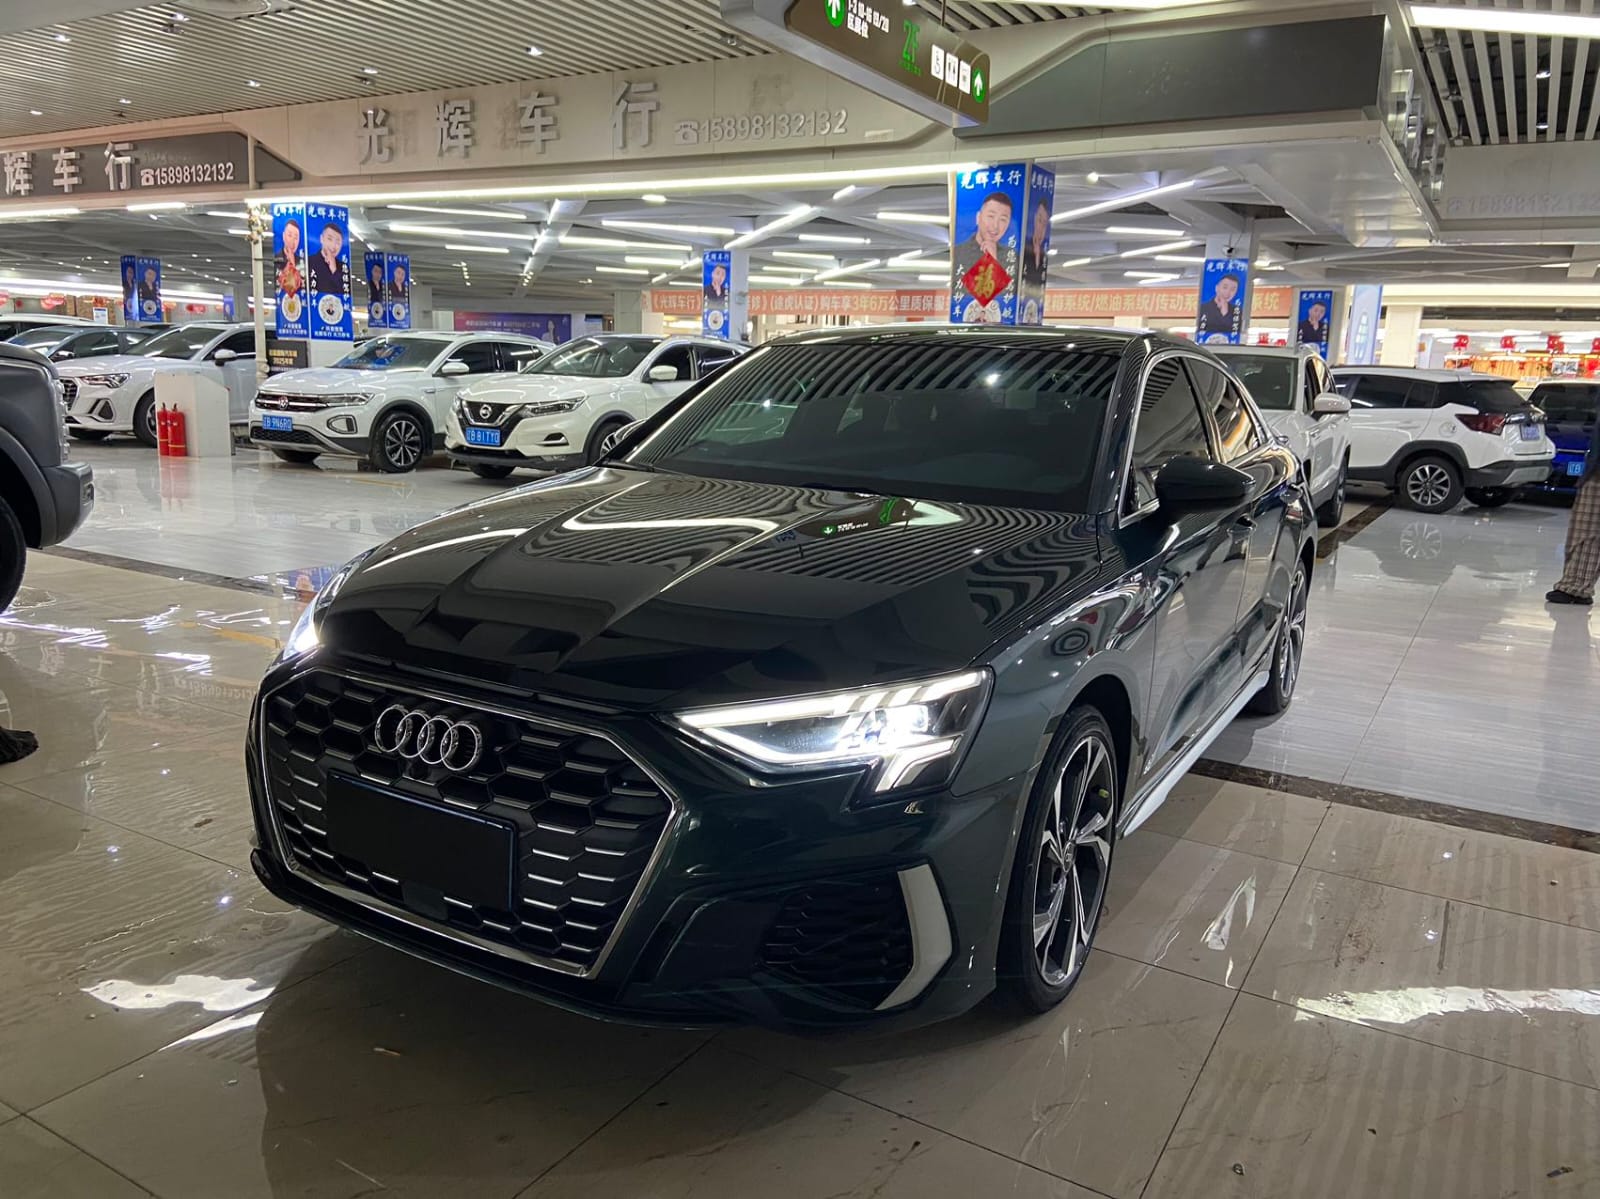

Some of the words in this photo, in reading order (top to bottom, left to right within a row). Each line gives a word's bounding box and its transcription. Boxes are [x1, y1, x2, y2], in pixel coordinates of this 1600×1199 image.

[359, 80, 660, 165] 光辉车行
[700, 109, 848, 144] 15898132132
[3, 142, 136, 195] 辉车行
[155, 161, 234, 185] 15898132132
[974, 263, 996, 299] 福
